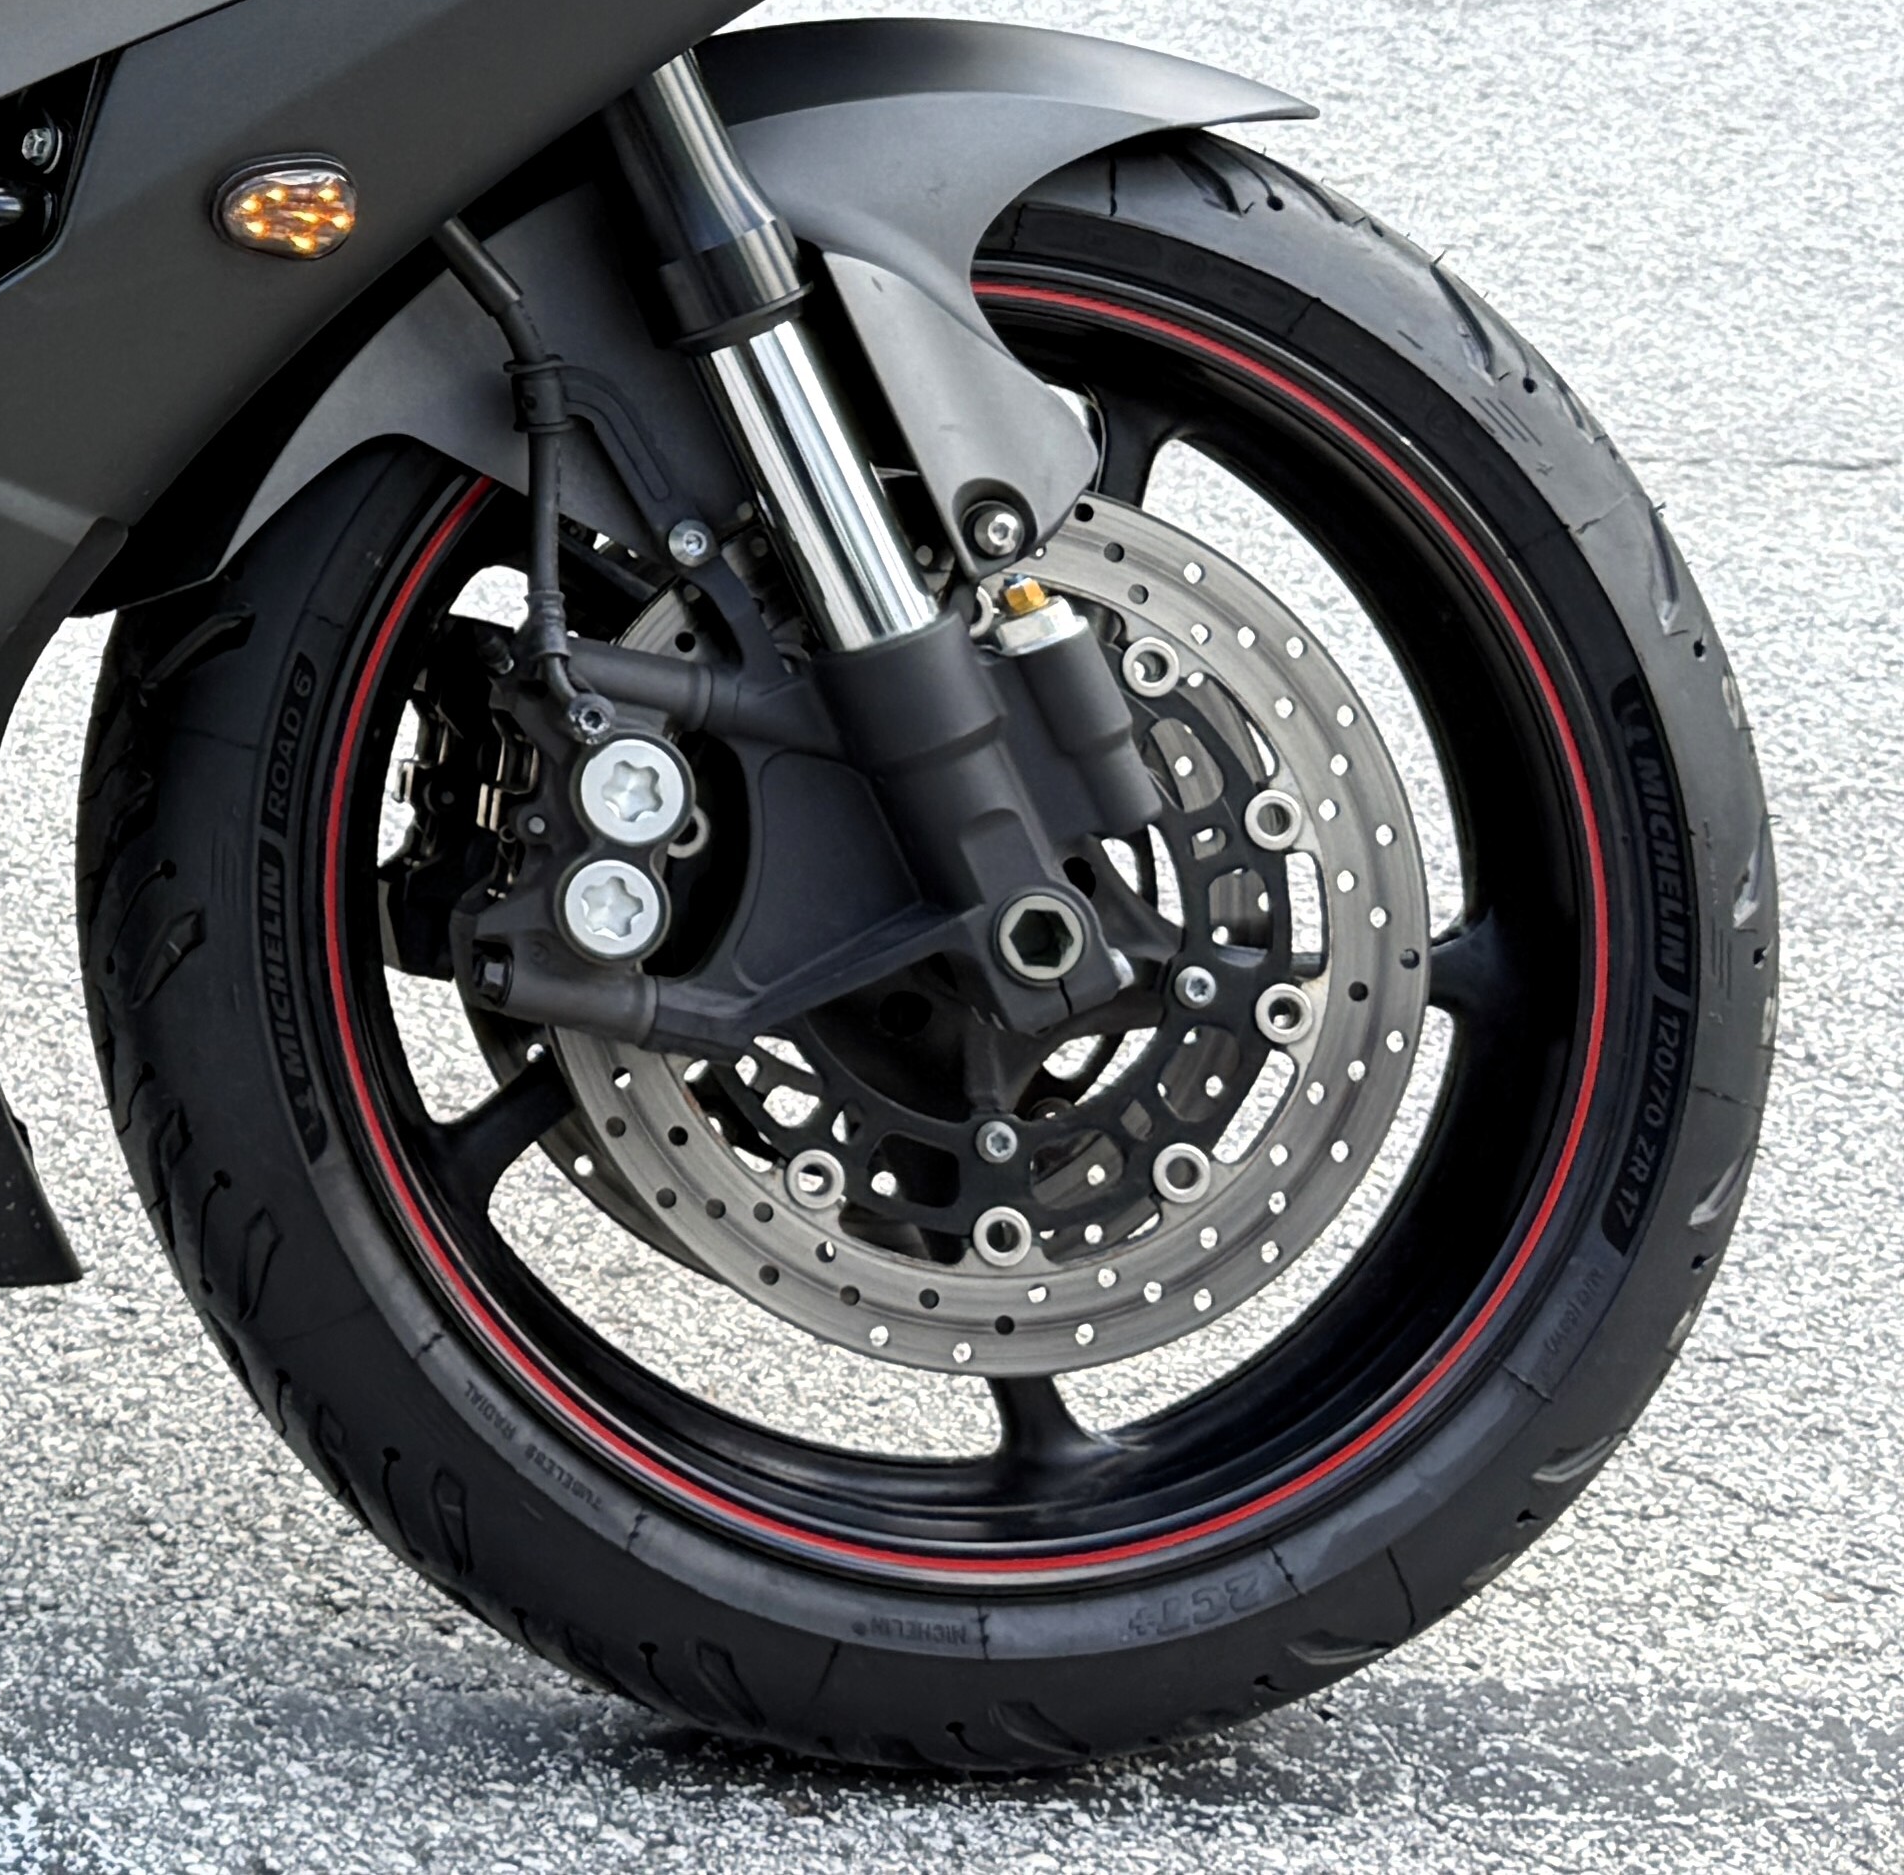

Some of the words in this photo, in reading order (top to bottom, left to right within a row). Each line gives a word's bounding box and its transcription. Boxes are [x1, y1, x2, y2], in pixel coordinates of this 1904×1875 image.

[295, 666, 312, 697] 6
[268, 705, 301, 820] ROAD
[1634, 754, 1686, 978] MICHELIN
[261, 861, 307, 1079] MICHELIN
[1645, 1013, 1681, 1126] 120/70
[1617, 1182, 1642, 1230] 17
[1628, 1135, 1657, 1188] ZR
